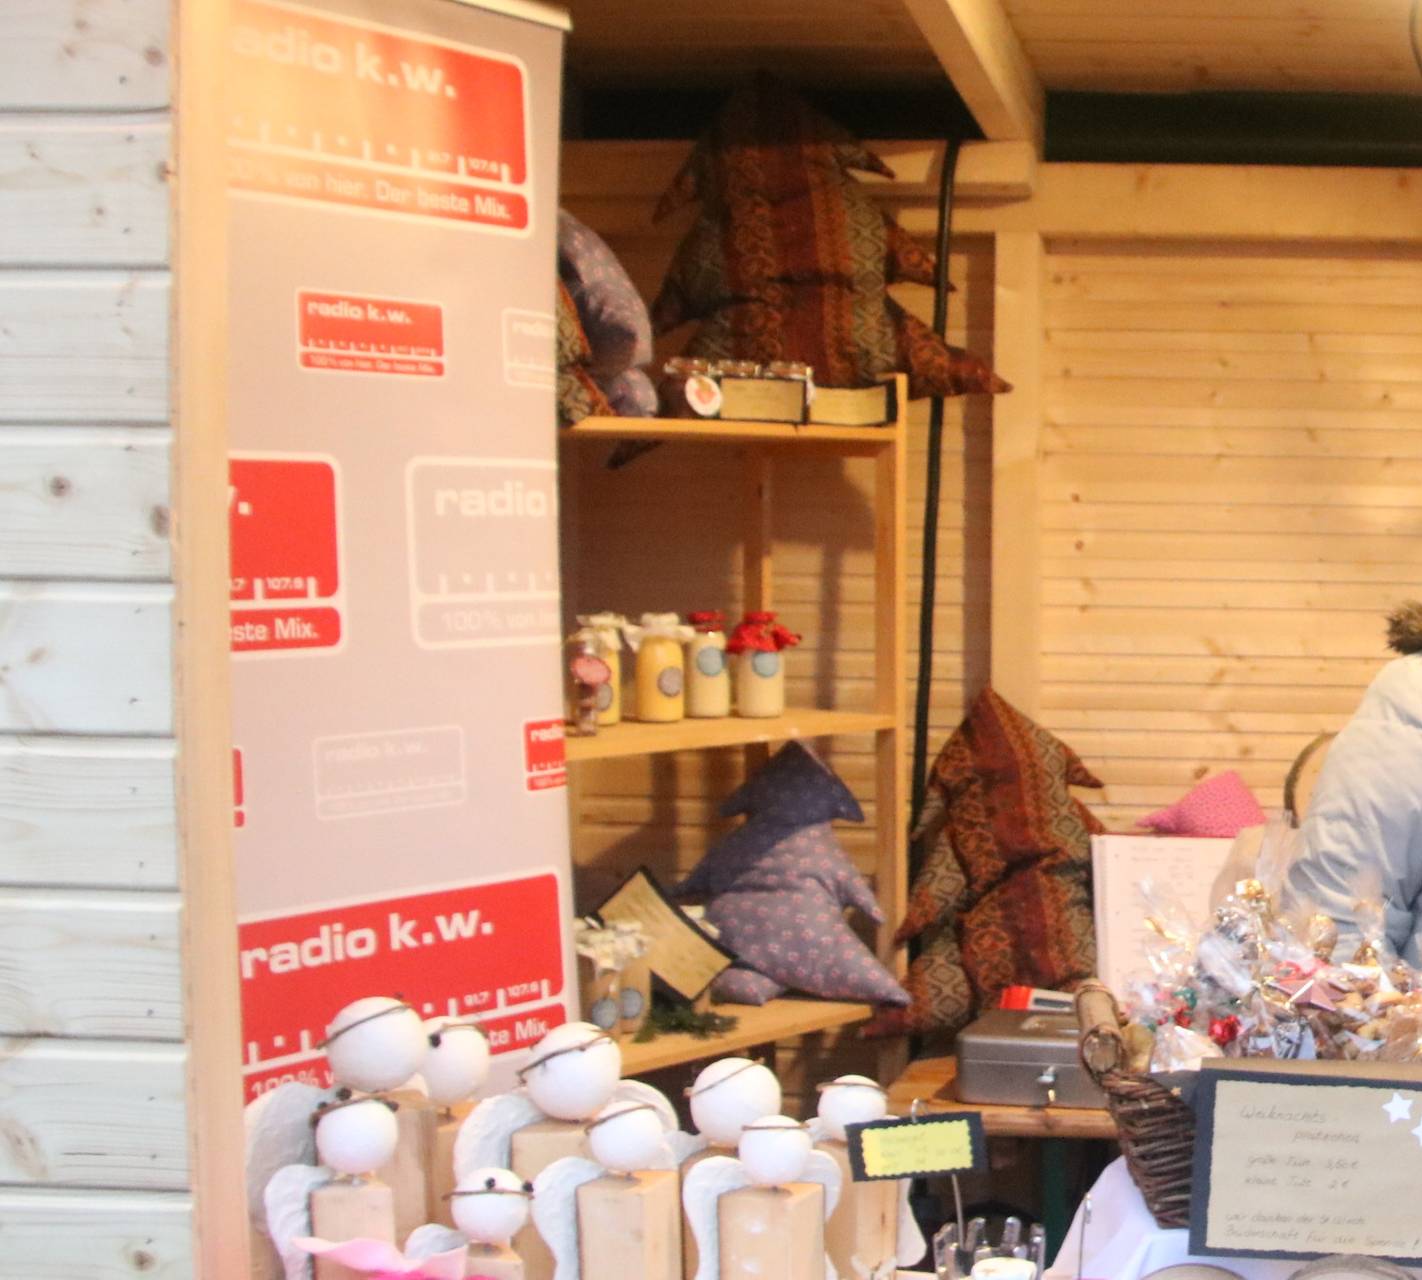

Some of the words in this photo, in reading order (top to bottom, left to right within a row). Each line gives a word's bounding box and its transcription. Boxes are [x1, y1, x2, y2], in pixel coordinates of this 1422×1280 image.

[231, 25, 342, 74] adio
[355, 41, 457, 99] k.w.
[375, 180, 411, 204] Der
[417, 187, 469, 214] beste
[307, 299, 364, 321] radio
[367, 303, 414, 325] k.w.
[435, 480, 548, 517] radio
[274, 617, 319, 641] Mix.
[240, 921, 378, 980] radio
[389, 909, 494, 951] k.w.
